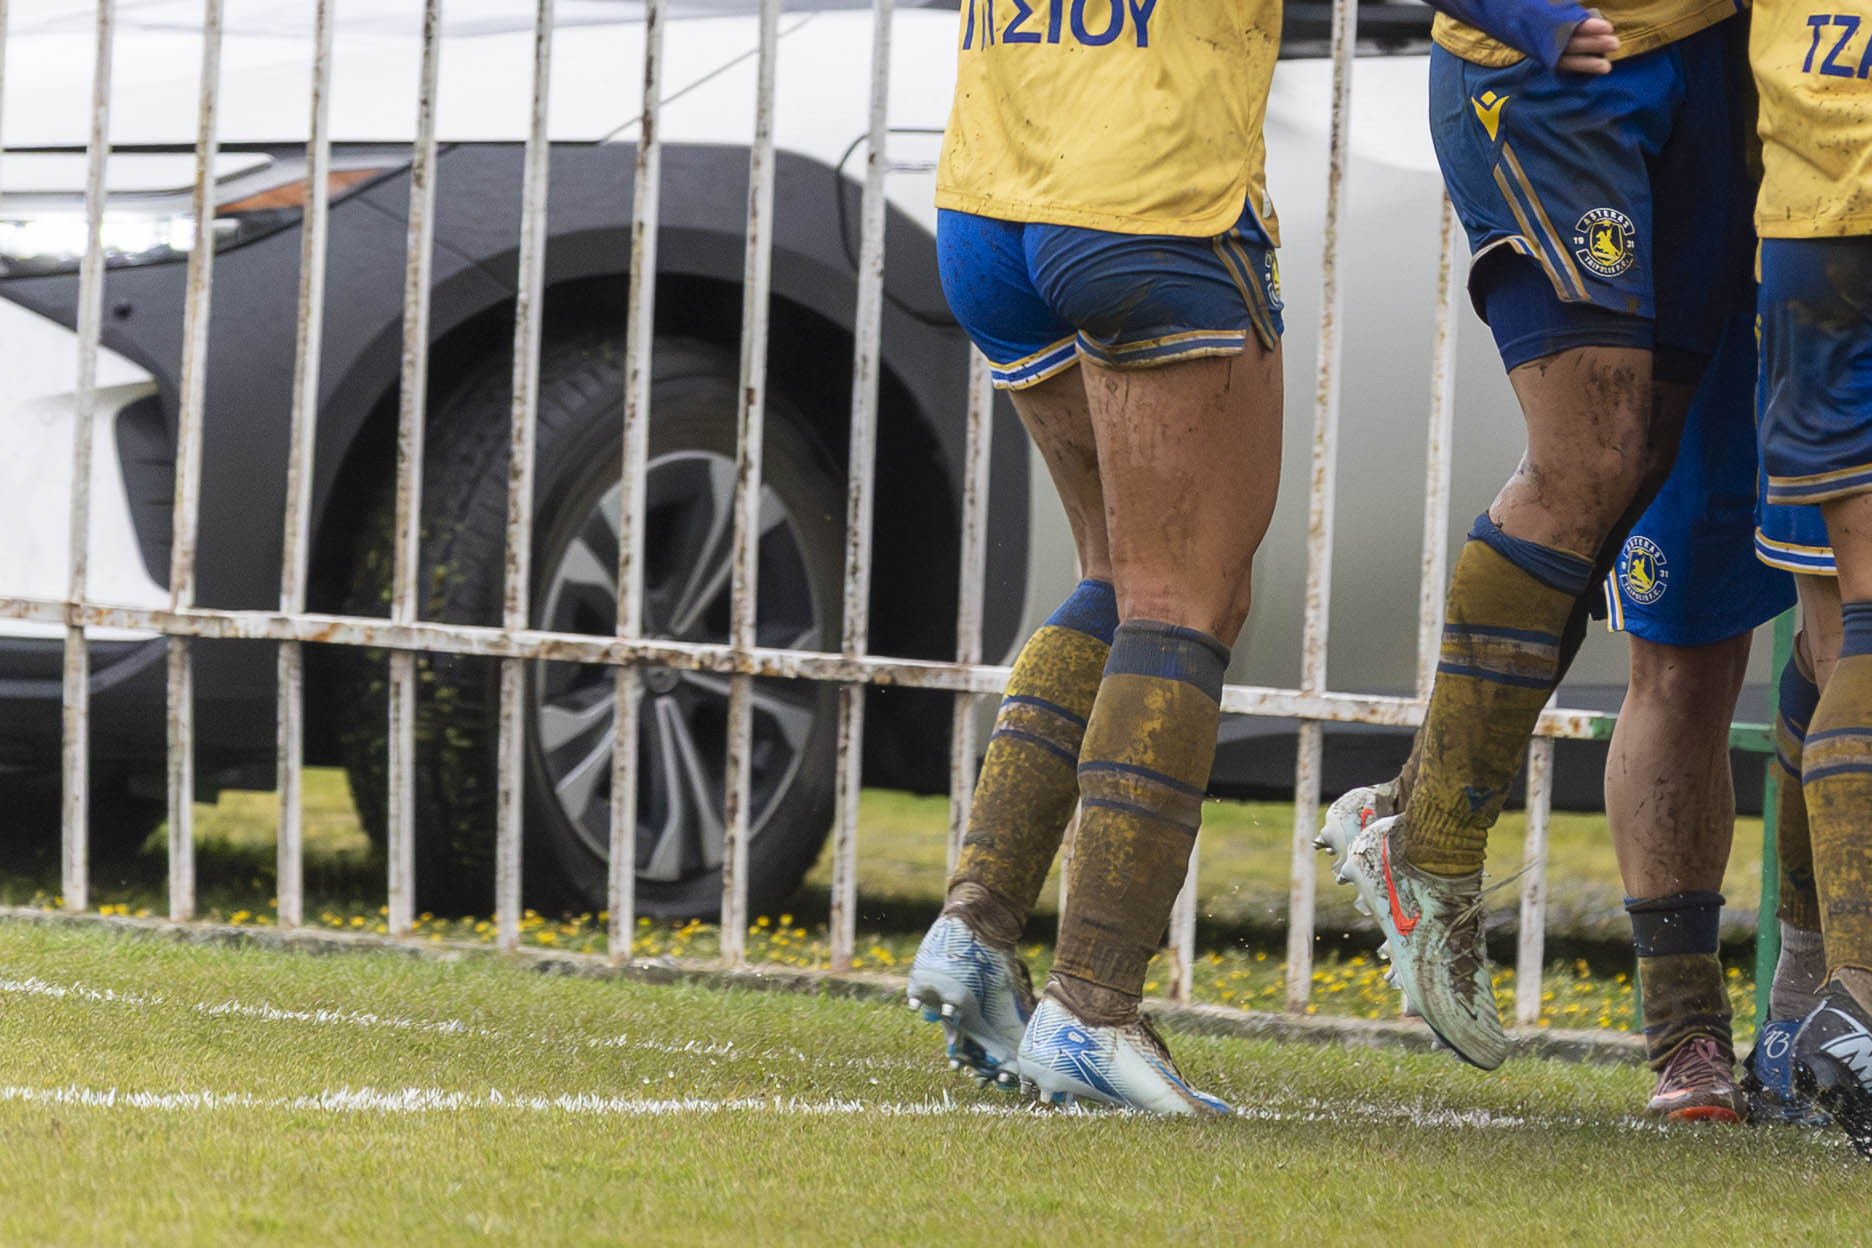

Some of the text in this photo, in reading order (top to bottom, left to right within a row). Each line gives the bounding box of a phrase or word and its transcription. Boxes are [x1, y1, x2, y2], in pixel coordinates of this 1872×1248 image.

[1584, 210, 1630, 228] ASTERAS
[1573, 236, 1584, 245] 19
[1626, 538, 1661, 558] ASTERAS
